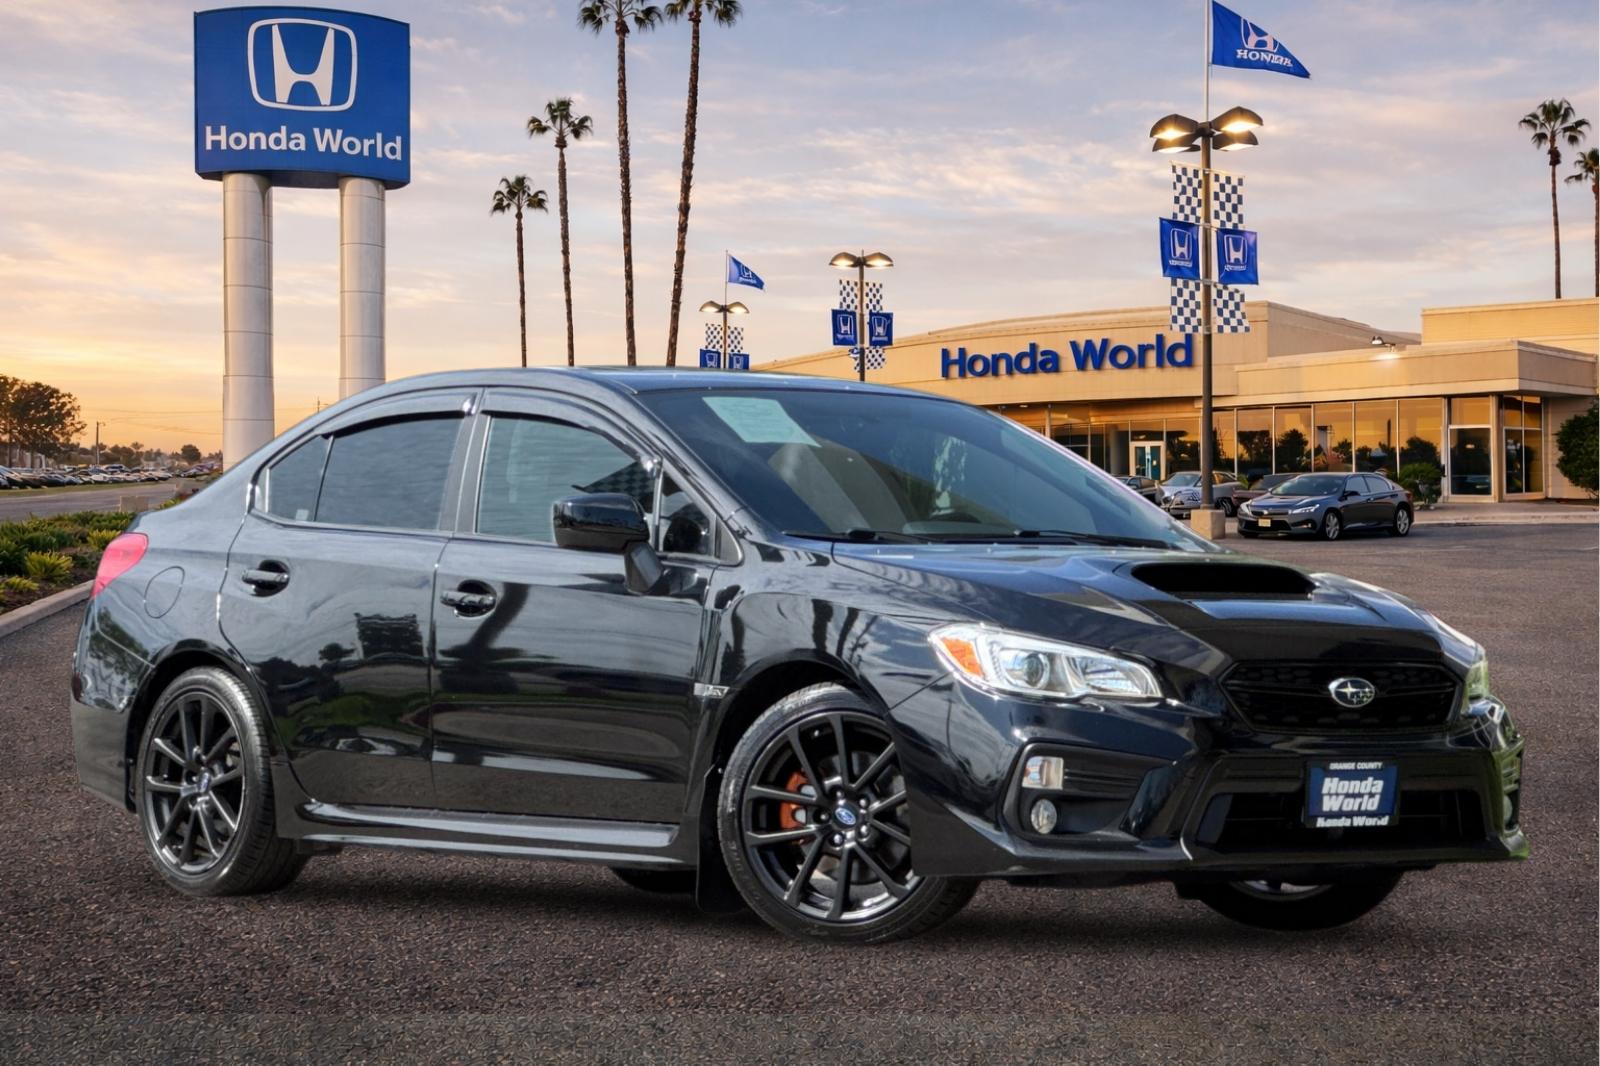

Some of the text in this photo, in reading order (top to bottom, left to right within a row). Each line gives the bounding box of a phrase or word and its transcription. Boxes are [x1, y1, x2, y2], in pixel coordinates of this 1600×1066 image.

[205, 125, 402, 161] Honda World
[941, 333, 1194, 379] Honda World
[1356, 761, 1383, 770] COUNTY
[1321, 776, 1384, 794] Honda
[1322, 794, 1381, 812] World
